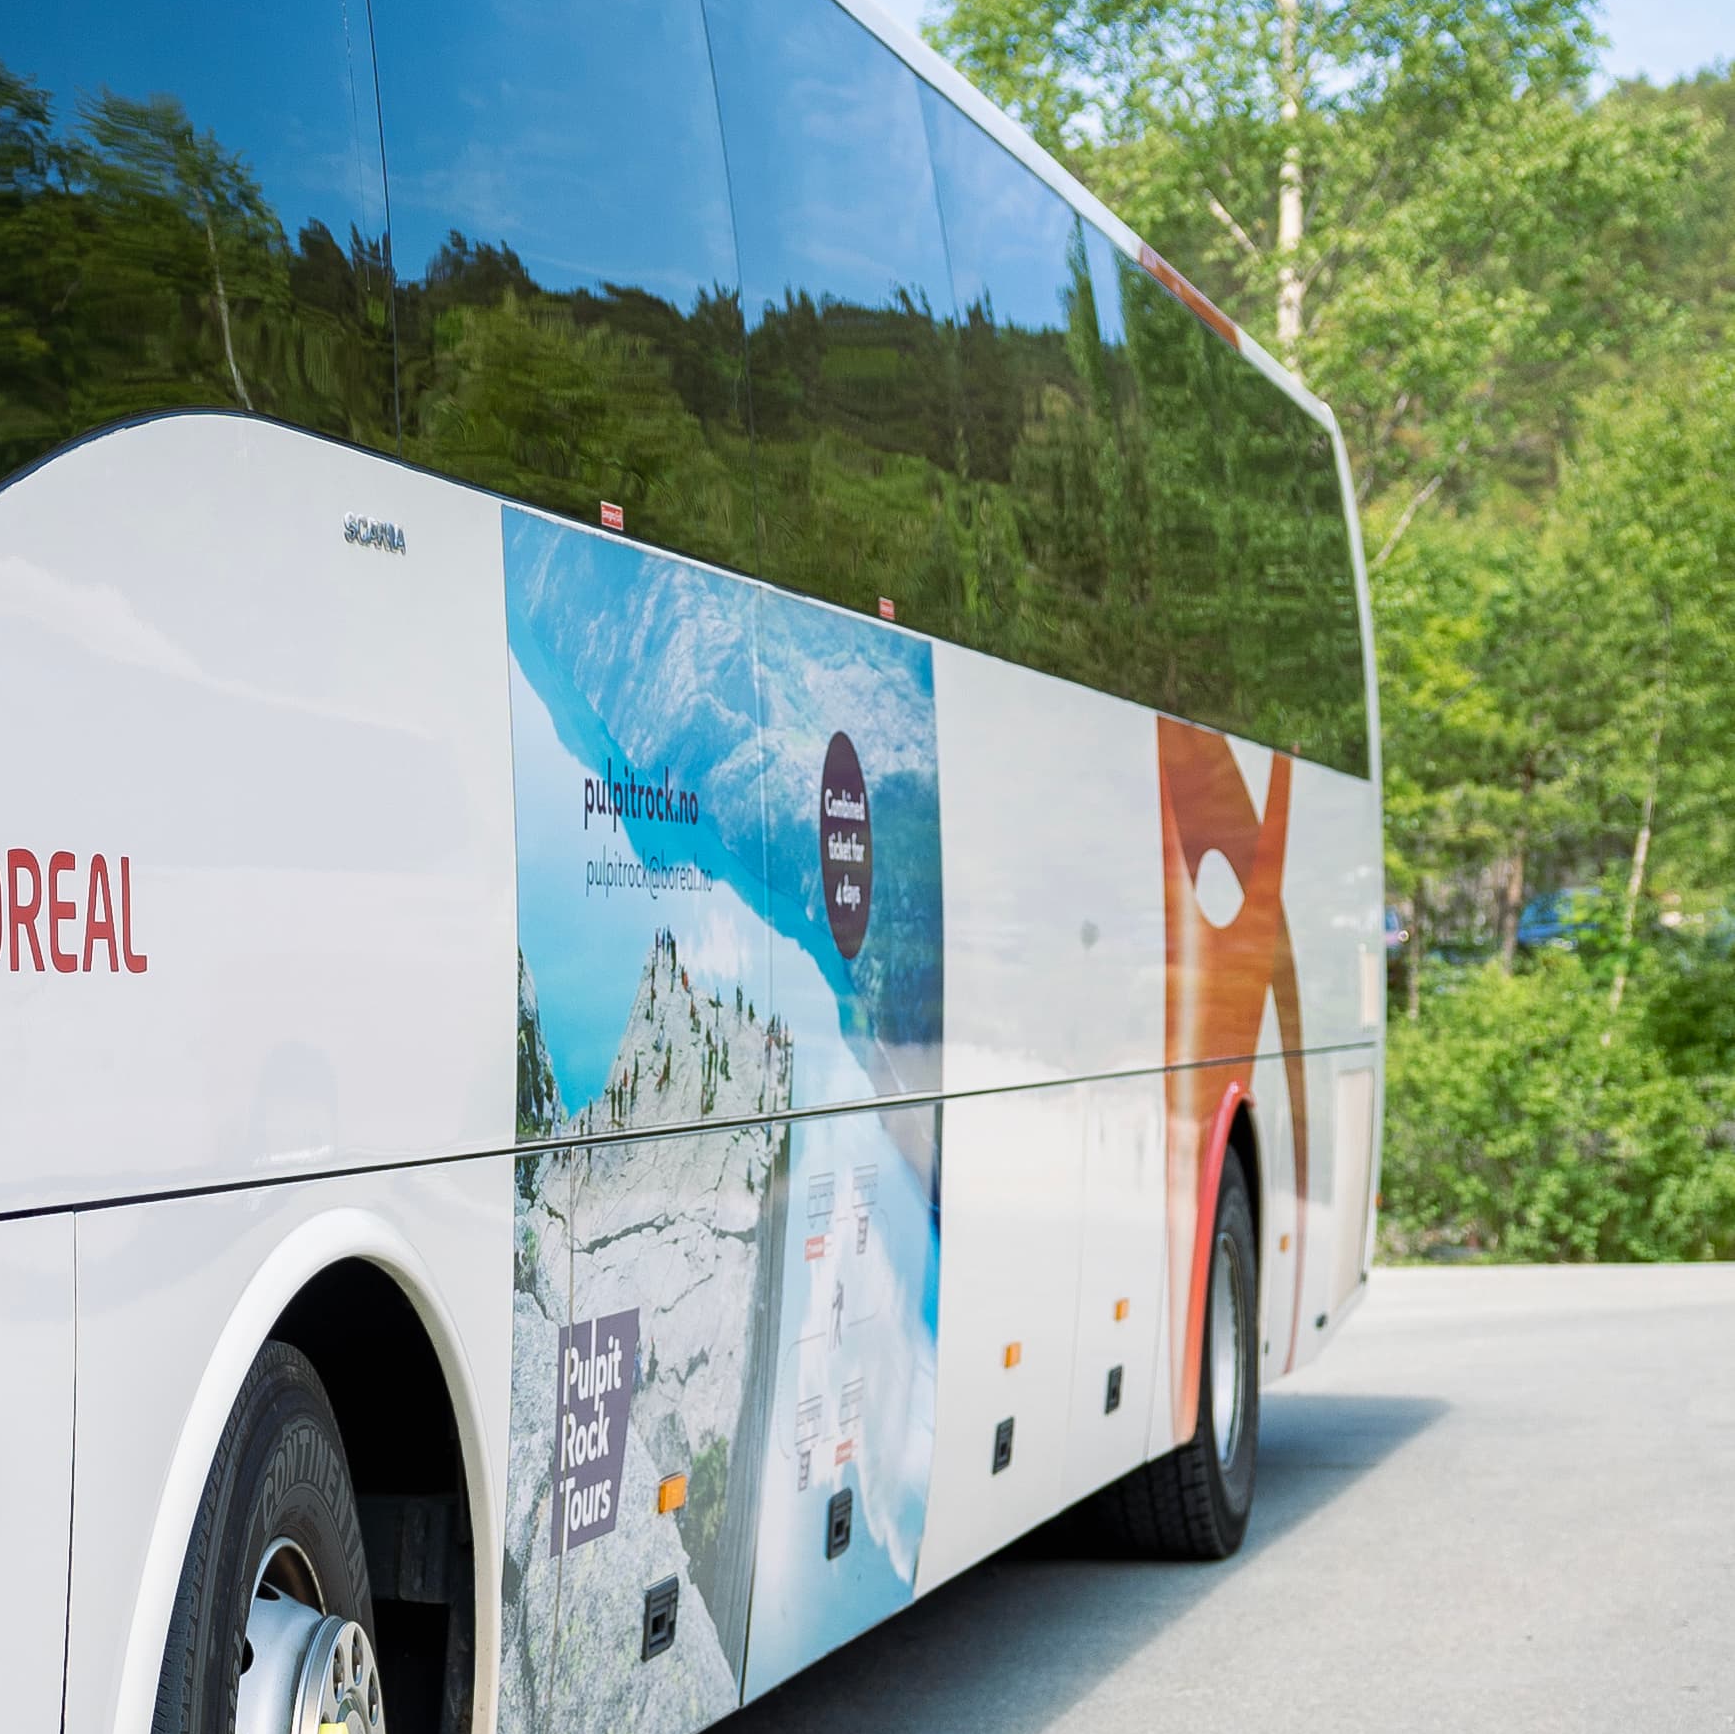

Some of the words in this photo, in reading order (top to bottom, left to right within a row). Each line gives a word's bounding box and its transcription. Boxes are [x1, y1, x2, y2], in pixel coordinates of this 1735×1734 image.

[343, 511, 406, 556] SCANIA
[584, 757, 698, 833] pulpitrock.no
[824, 787, 866, 821] Combined
[586, 844, 714, 900] pulpitrock@boreal.no
[563, 1318, 623, 1412] Pulpit
[560, 1400, 610, 1472] Rock
[559, 1477, 612, 1551] Tours
